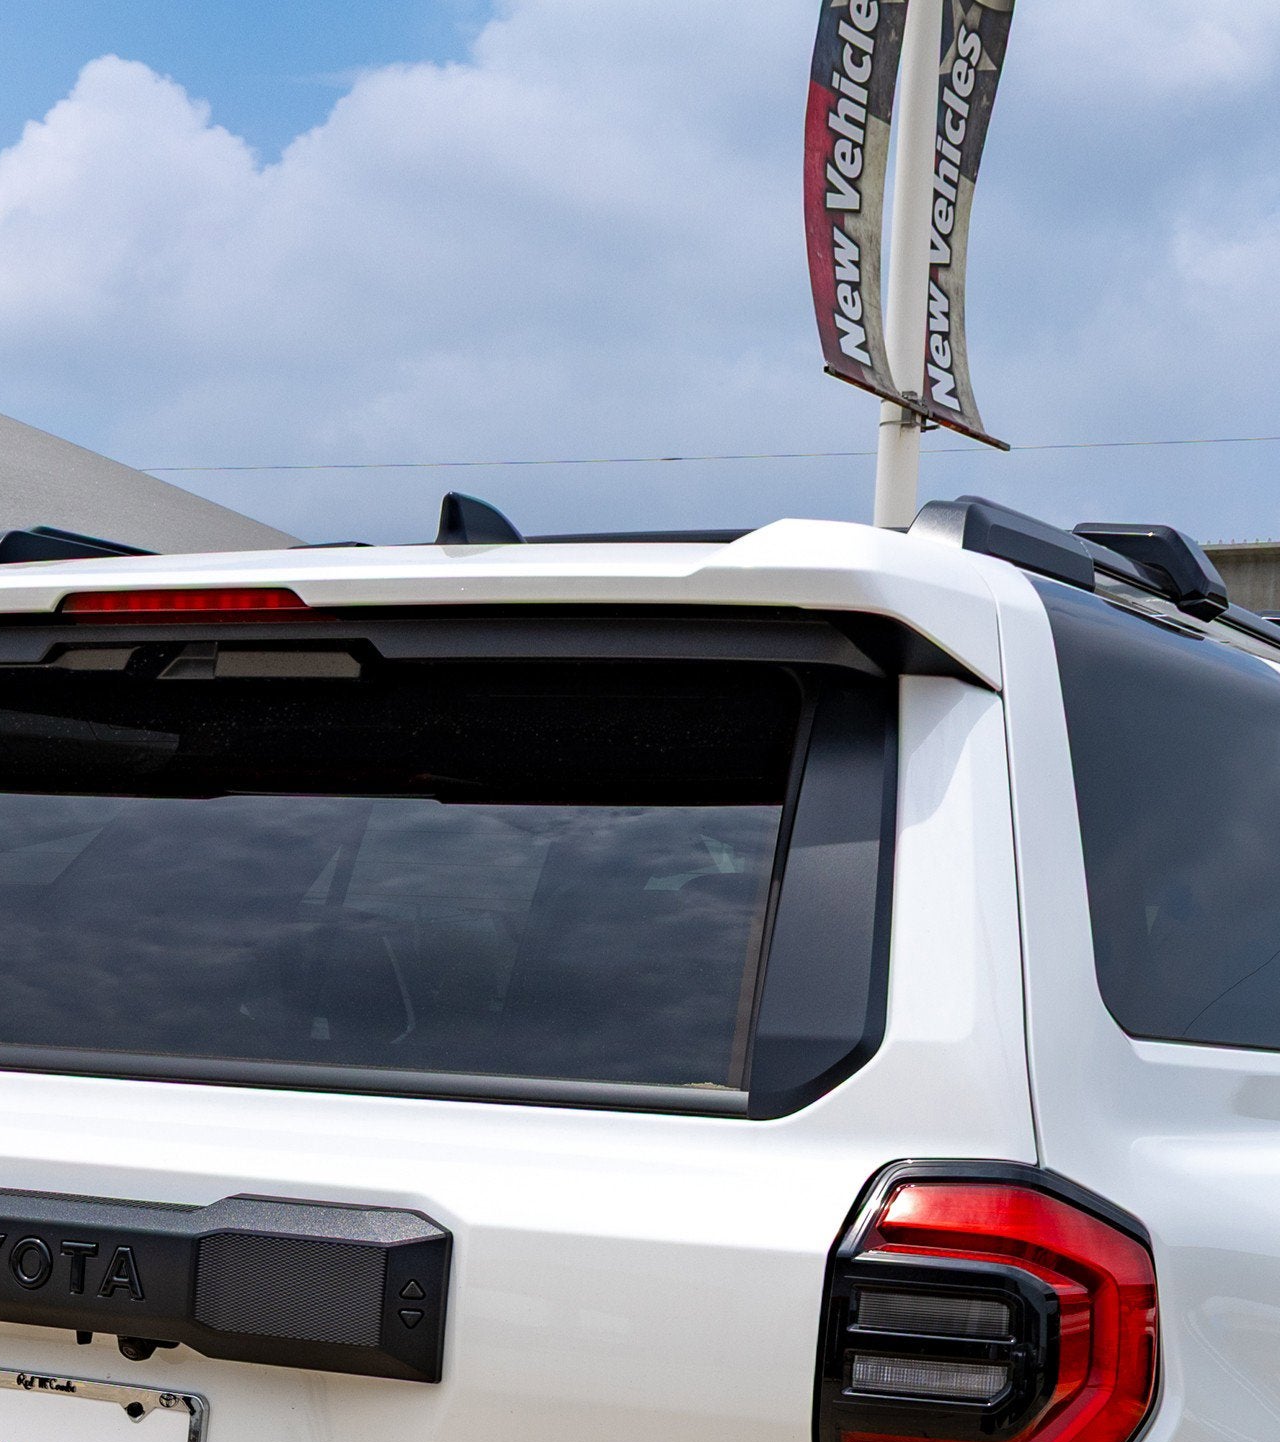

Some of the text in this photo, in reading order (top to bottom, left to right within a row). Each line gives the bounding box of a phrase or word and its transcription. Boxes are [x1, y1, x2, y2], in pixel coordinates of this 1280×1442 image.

[833, 226, 873, 367] New
[927, 25, 982, 411] New Vehicles
